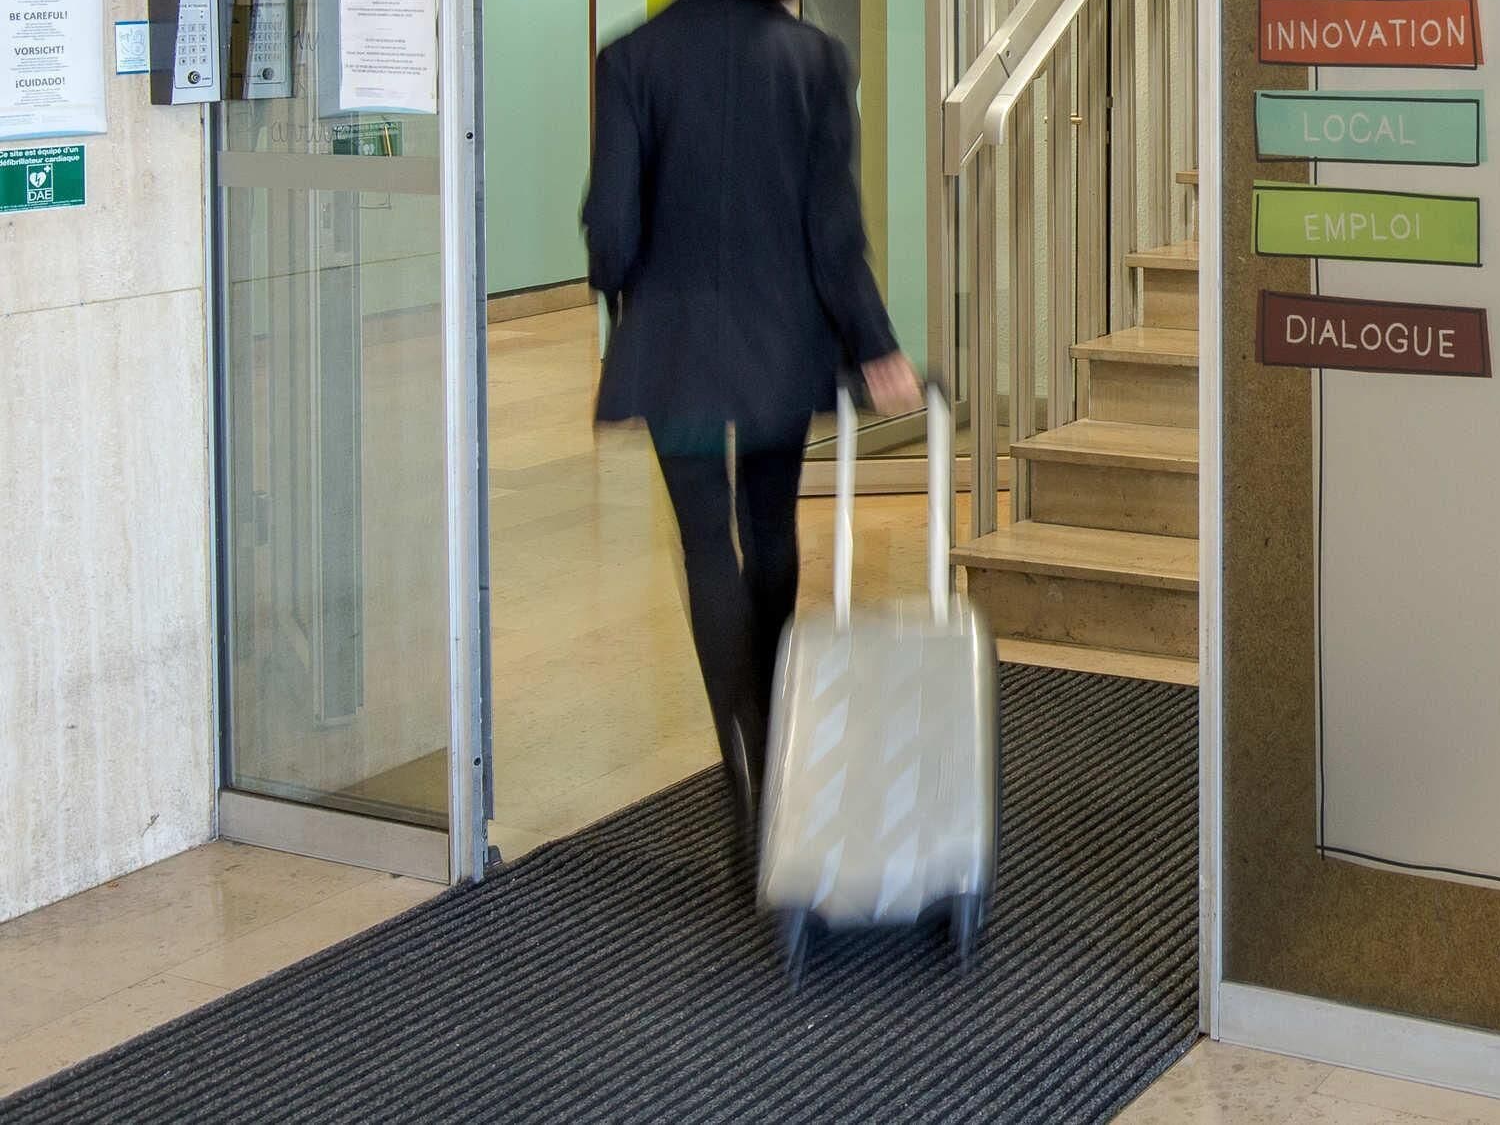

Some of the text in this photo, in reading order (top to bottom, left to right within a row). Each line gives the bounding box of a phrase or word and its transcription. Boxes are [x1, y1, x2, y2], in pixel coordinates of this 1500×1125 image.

[9, 11, 68, 21] BE CAREFUL!
[1267, 16, 1465, 50] INNOVATION
[14, 46, 65, 56] VORSICHT!
[1303, 112, 1416, 146] LOCAL
[28, 190, 52, 202] DAE
[1304, 213, 1421, 241] EMPLOI
[1286, 314, 1455, 359] DIALOGUE
